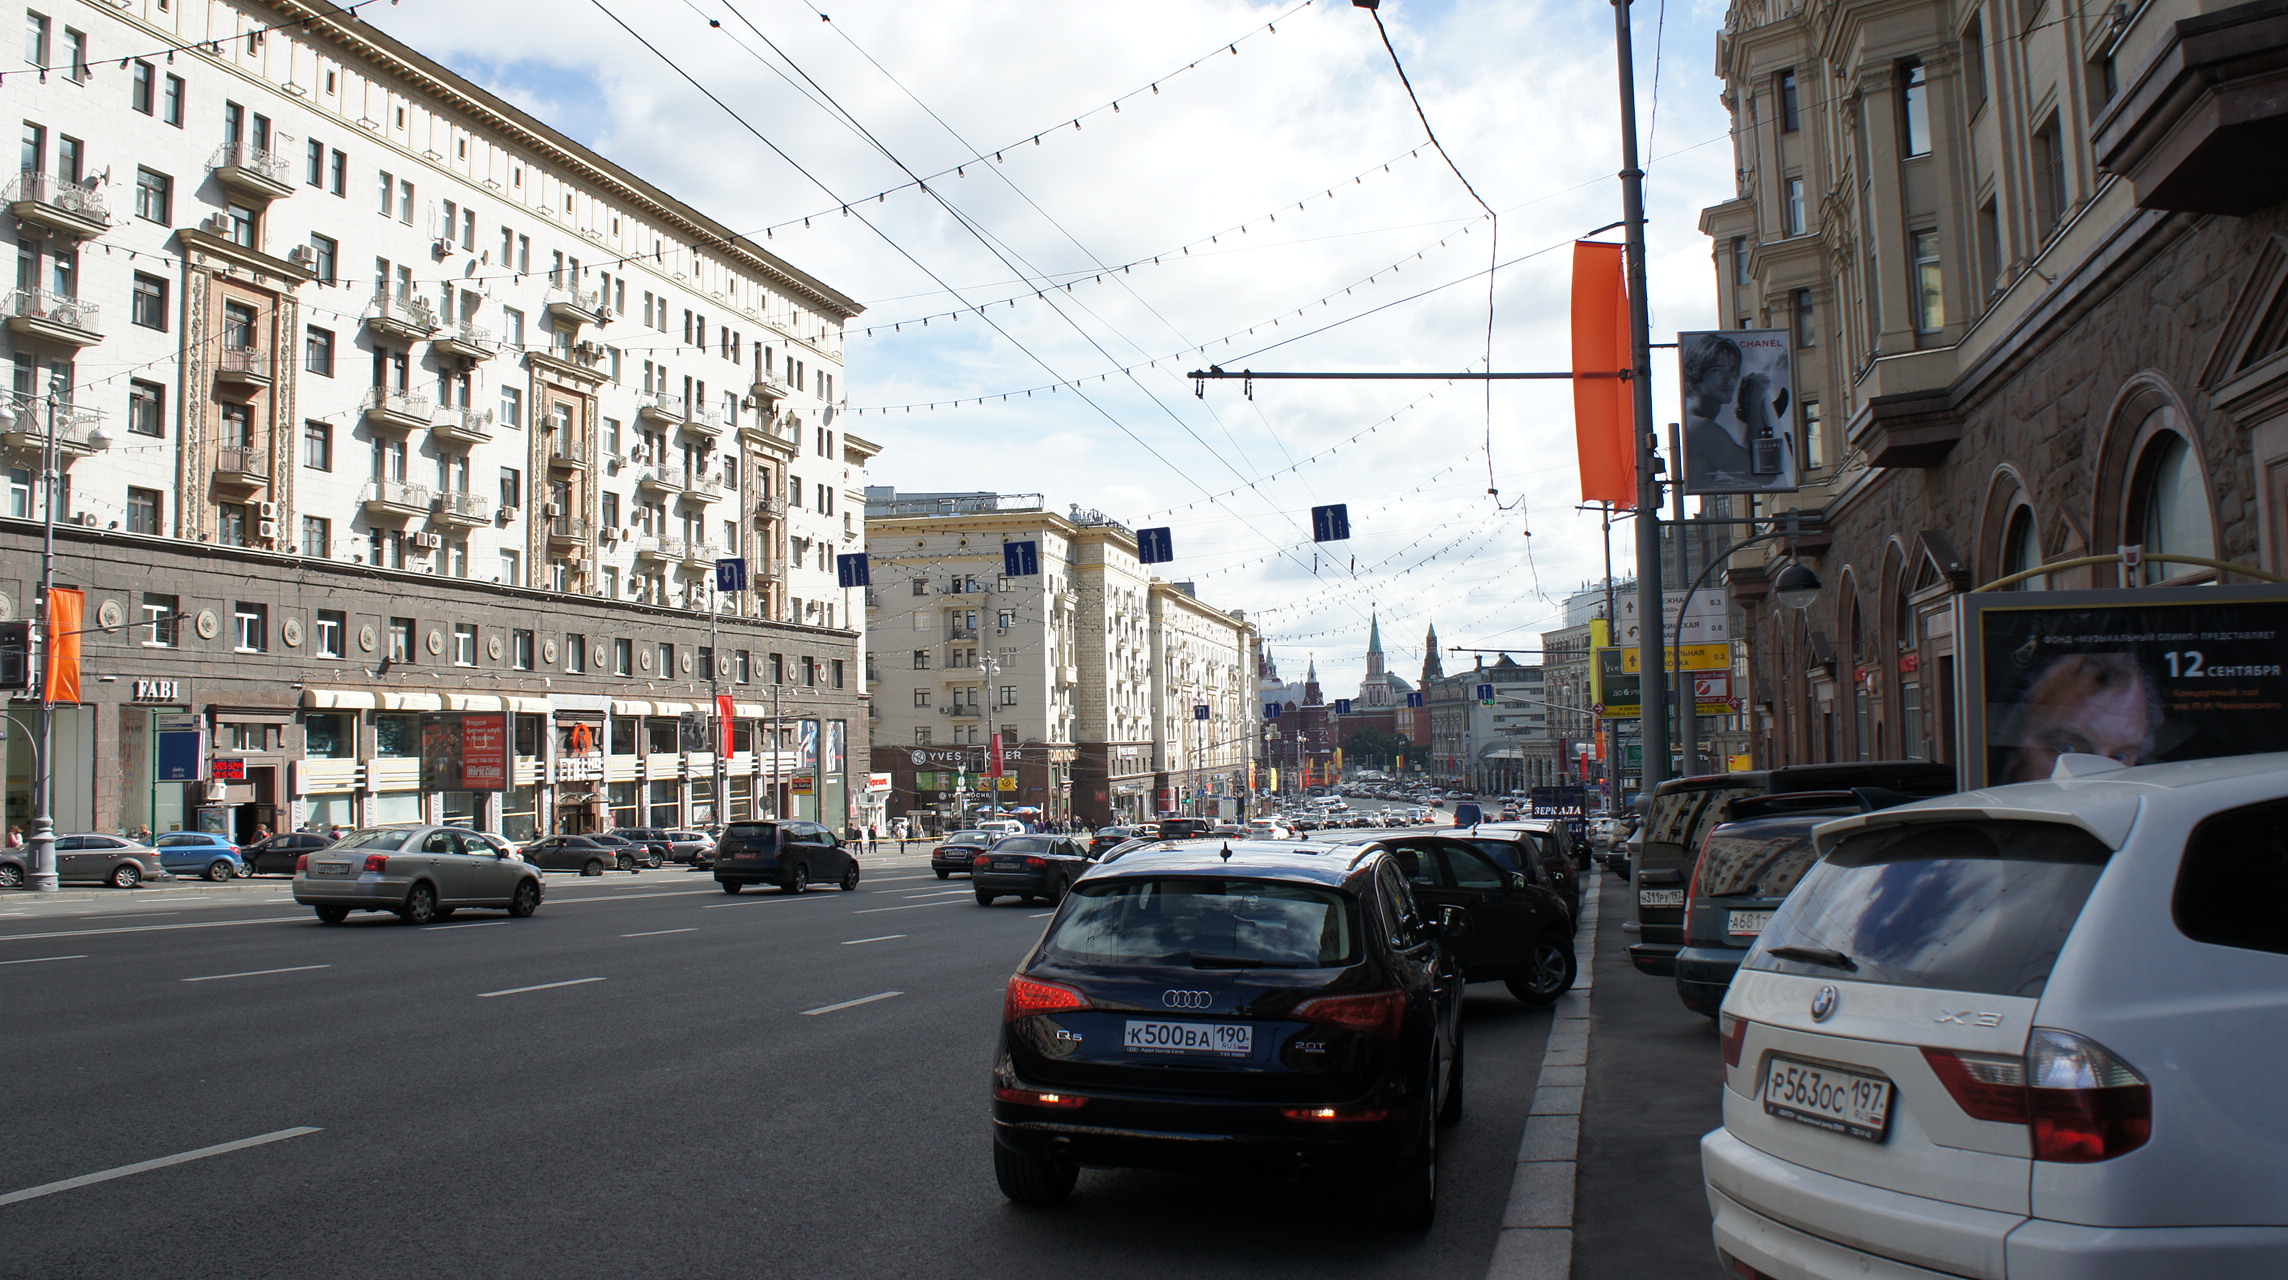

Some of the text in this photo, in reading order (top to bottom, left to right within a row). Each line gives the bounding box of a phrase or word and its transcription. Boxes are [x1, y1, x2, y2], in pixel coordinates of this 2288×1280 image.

[1739, 339, 1783, 349] CHANEL
[2043, 634, 2073, 645] ФОНД
[2201, 630, 2276, 641] ПРЕДСТАВЛЯЕТ
[2163, 650, 2282, 678] 12 СЕНТЯБРЯ
[1694, 672, 1712, 680] редит
[136, 679, 179, 699] FABI
[1623, 688, 1629, 696] 6
[929, 752, 962, 761] YVES
[1641, 890, 1681, 904] Н311РУ 197
[1731, 913, 1772, 929] А681Т
[1933, 1008, 2004, 1028] X3
[1056, 1029, 1083, 1042] Q5
[1130, 1024, 1246, 1048] К500ВА 190
[1221, 1042, 1238, 1050] RUS
[1772, 1066, 1882, 1114] Р563ОС 197
[1853, 1108, 1871, 1122] RUS
